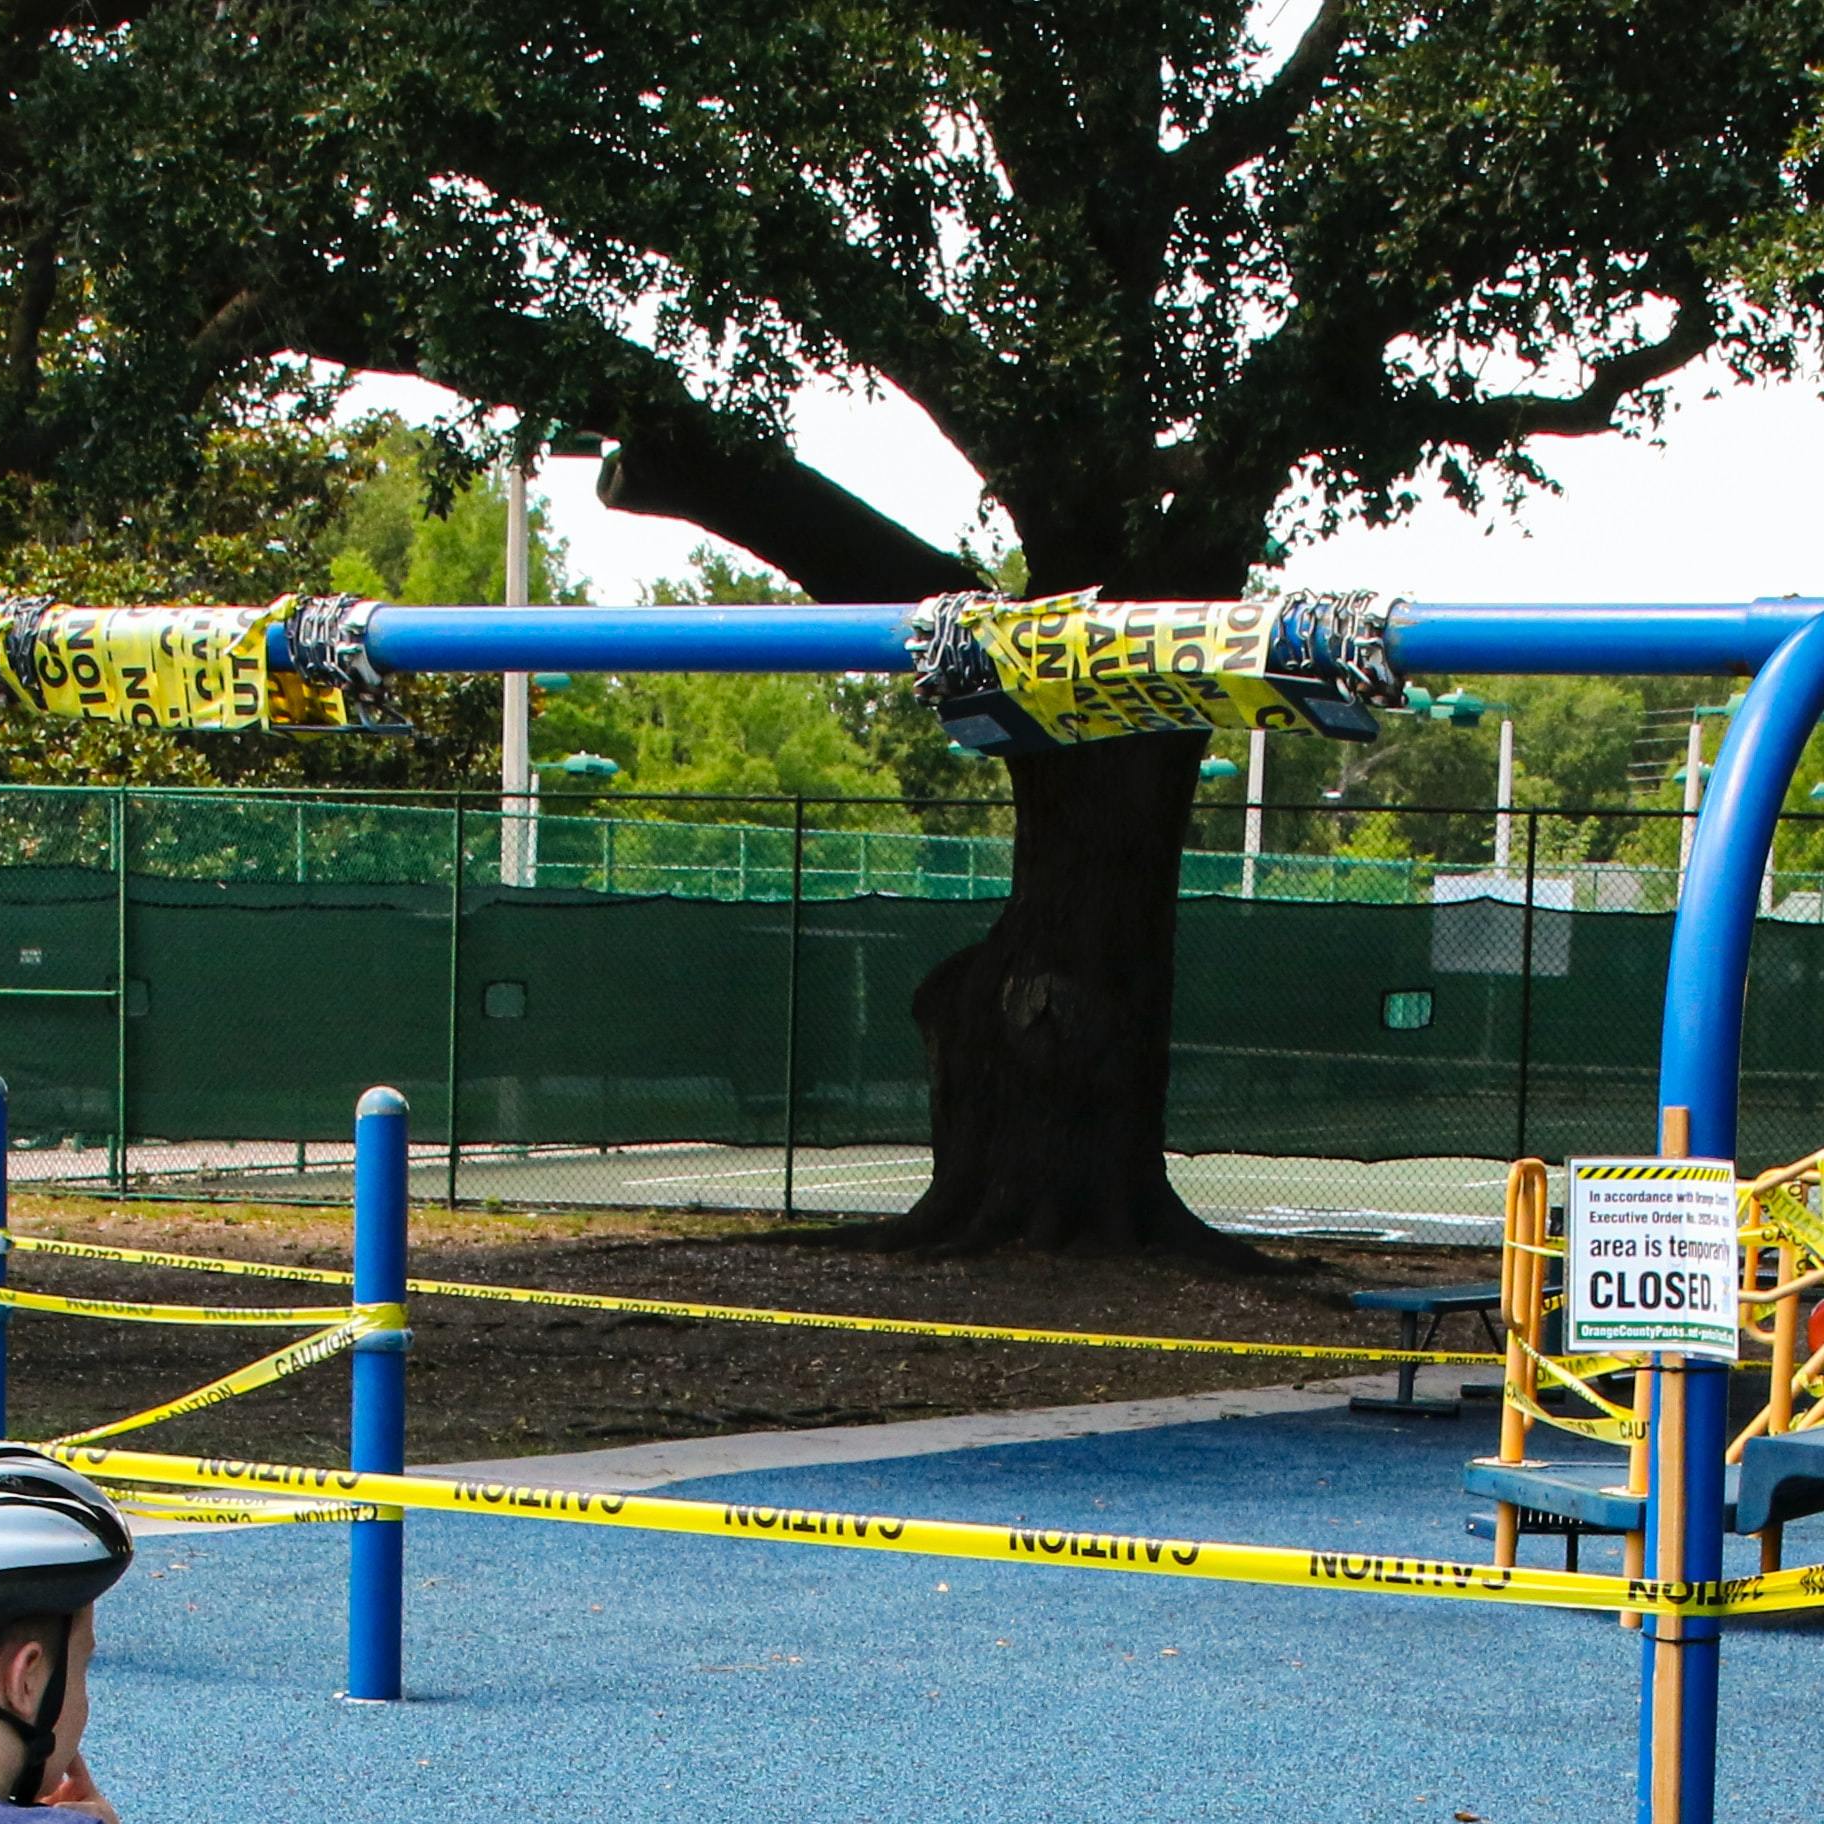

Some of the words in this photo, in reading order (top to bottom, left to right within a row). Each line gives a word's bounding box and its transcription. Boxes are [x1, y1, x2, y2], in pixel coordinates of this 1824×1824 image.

[1589, 1191, 1601, 1203] In
[1604, 1191, 1673, 1203] accordance
[1589, 1211, 1648, 1224] Executive
[1652, 1211, 1683, 1225] Order
[1590, 1238, 1637, 1258] area
[1645, 1234, 1662, 1258] is
[1669, 1235, 1730, 1267] temporarily
[1589, 1270, 1718, 1313] CLOSED.
[274, 1325, 357, 1379] CAUTION
[197, 1458, 362, 1489] CAUTION
[455, 1480, 626, 1514] CAUTION
[724, 1504, 906, 1541] CAUTION
[1009, 1527, 1200, 1566] CAUTION
[1311, 1550, 1513, 1591] CAUTION
[293, 1503, 378, 1524] CAUTION
